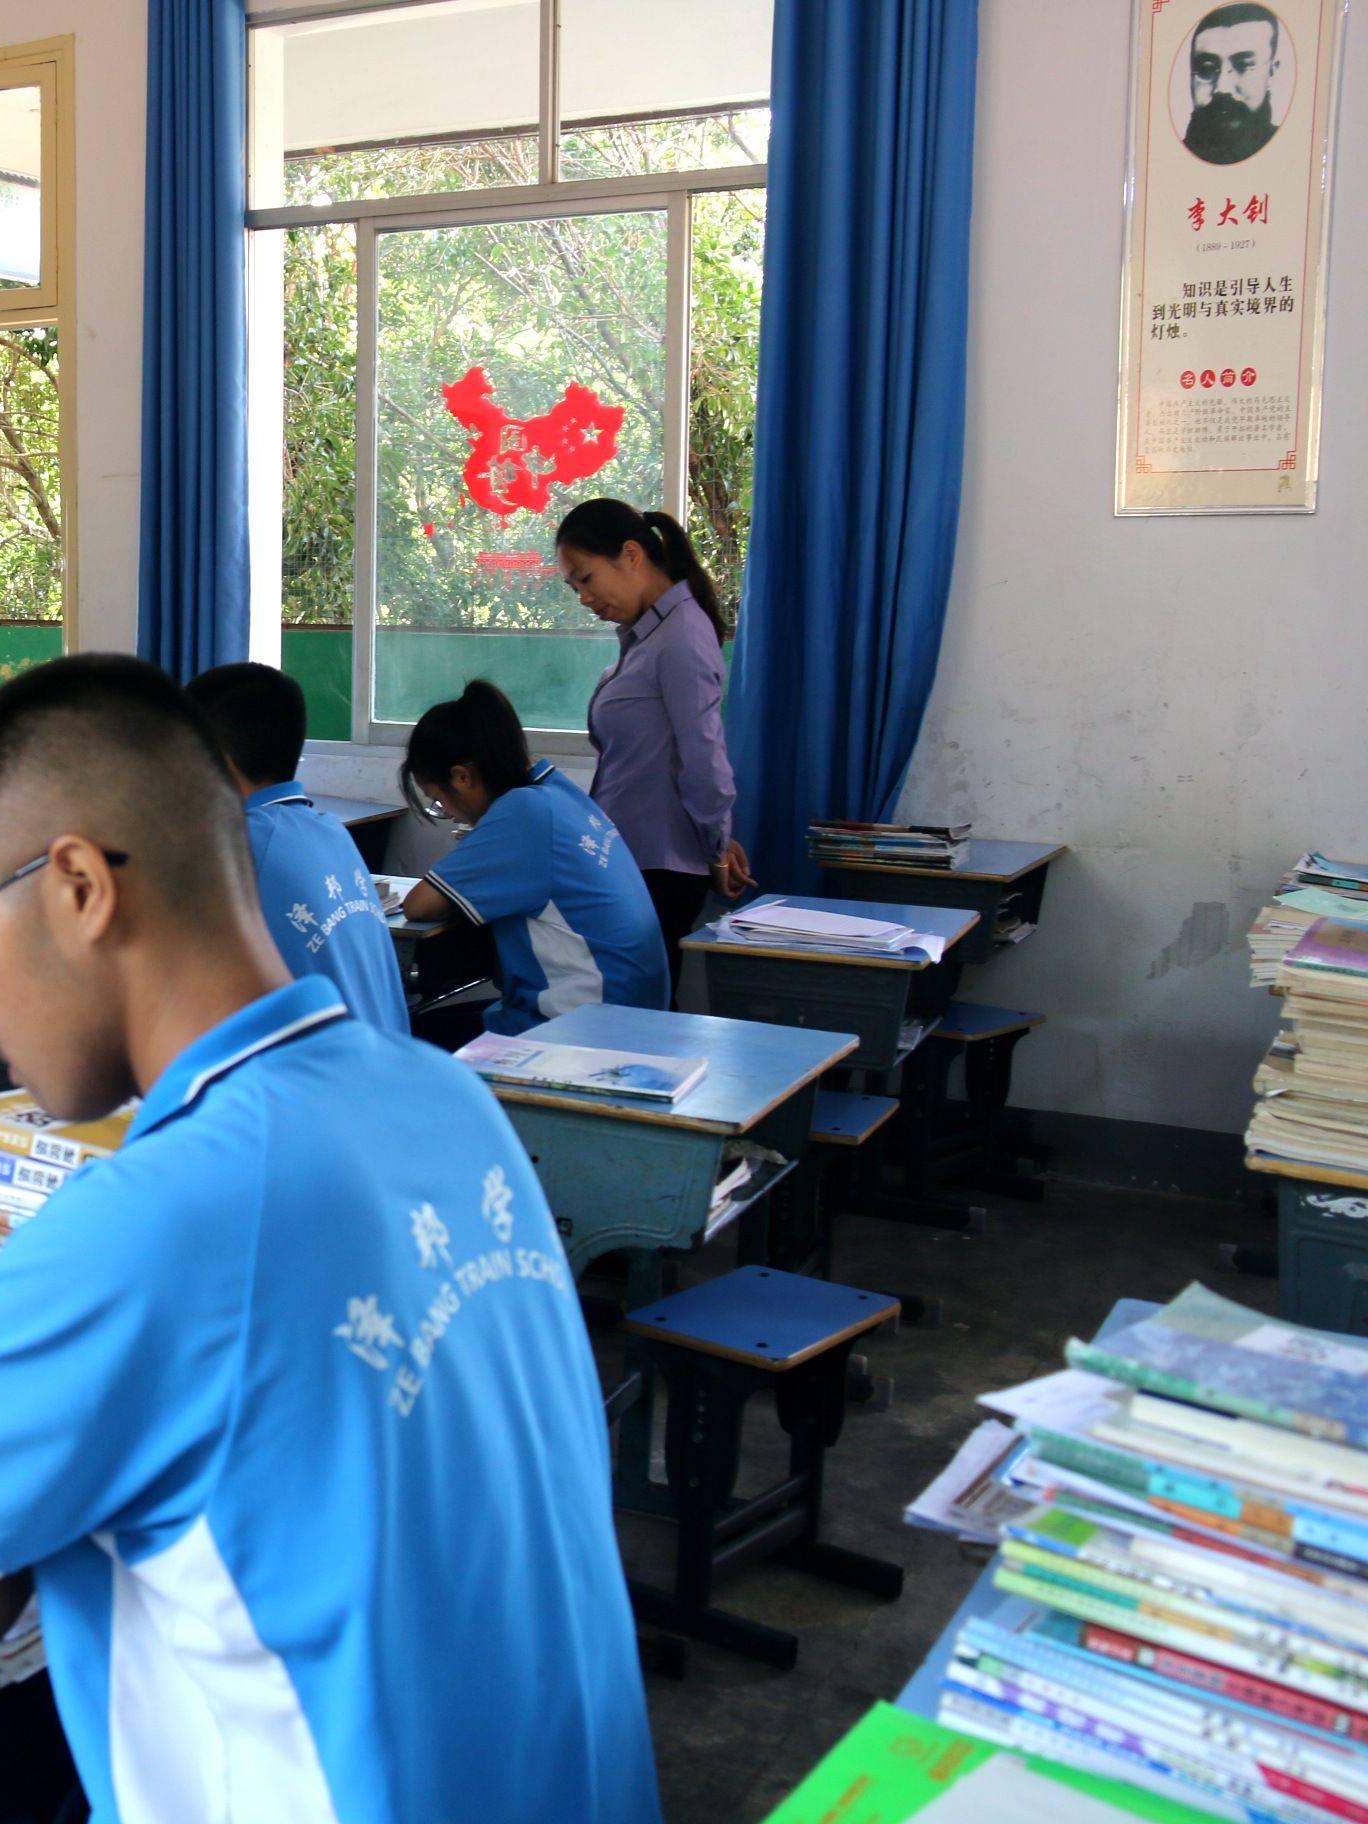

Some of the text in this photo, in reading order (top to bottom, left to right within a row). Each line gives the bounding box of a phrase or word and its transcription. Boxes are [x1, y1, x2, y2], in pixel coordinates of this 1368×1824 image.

[1182, 275, 1293, 299] 知识是引导人生
[1151, 295, 1294, 321] 到光明与真实境界的
[1180, 368, 1257, 389] 名人简介
[306, 932, 326, 954] ZE
[320, 906, 347, 936] BANG
[389, 1366, 423, 1417] ZE
[409, 1281, 461, 1369] BANG
[453, 1249, 514, 1296] TRAIN
